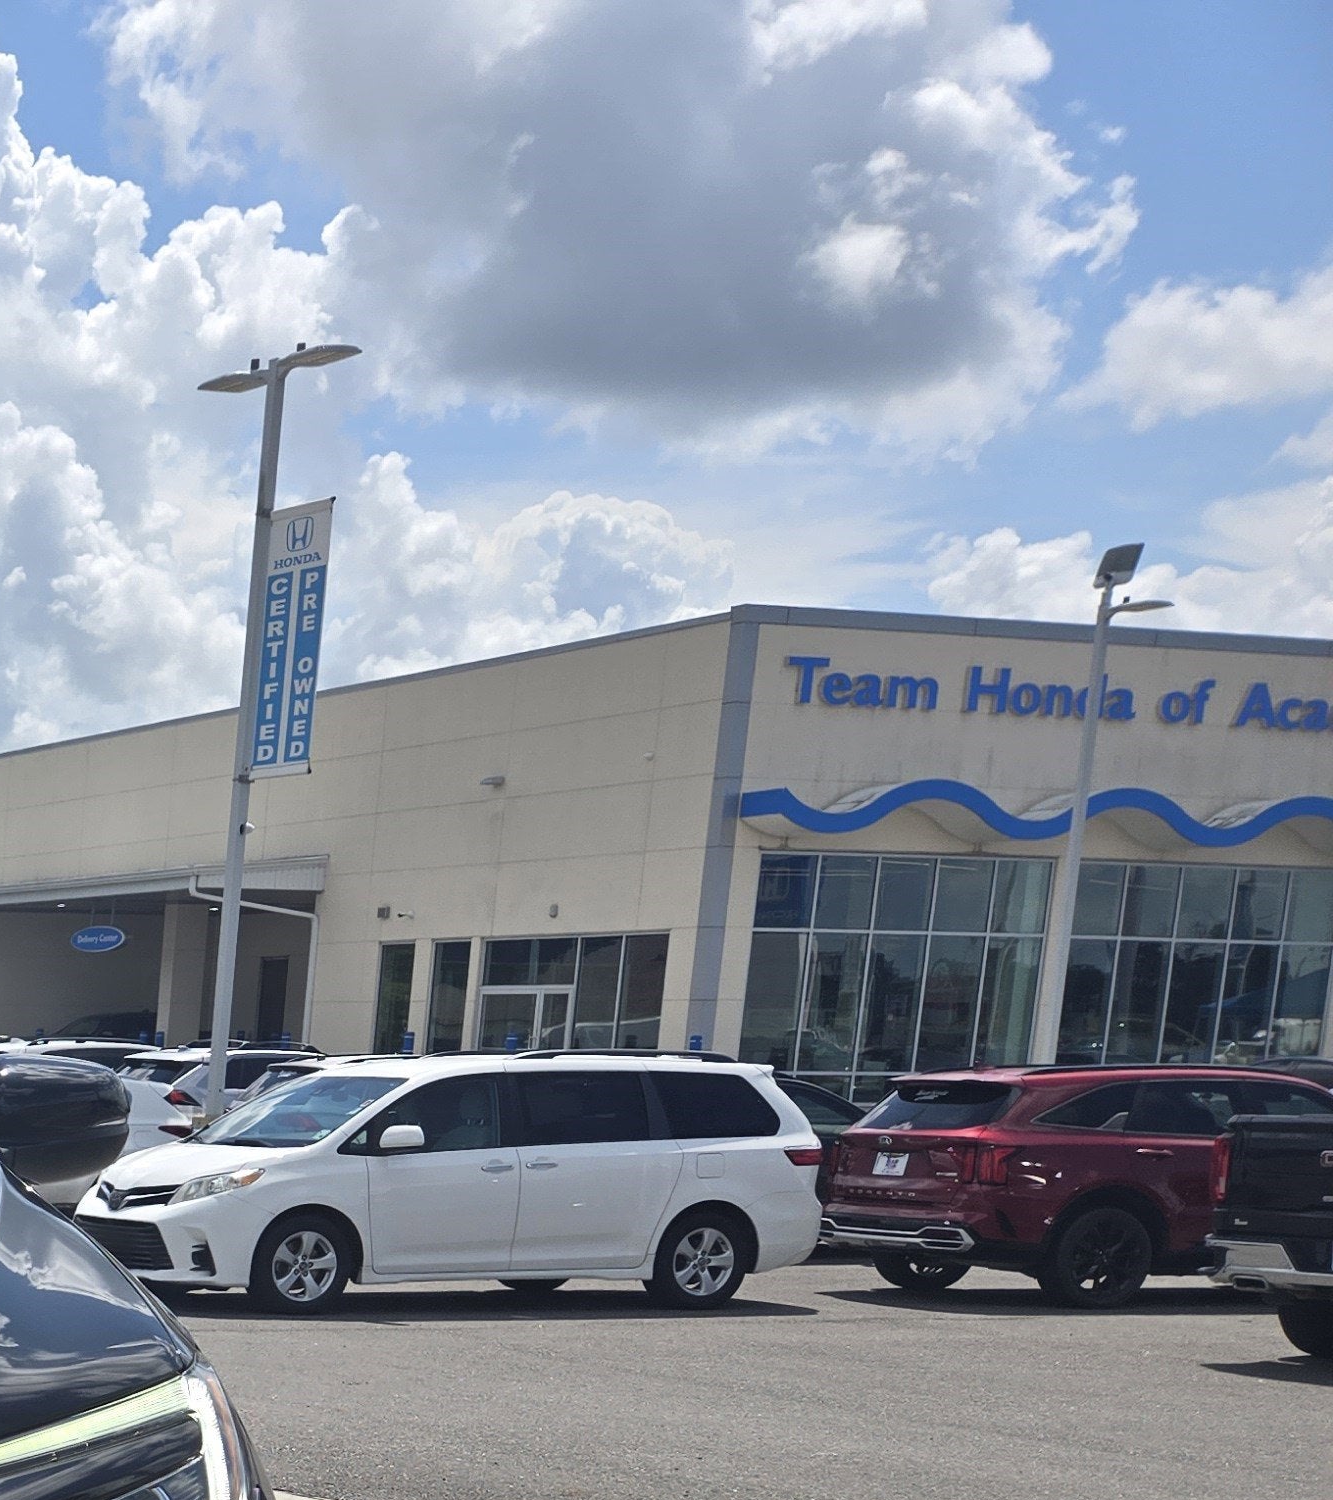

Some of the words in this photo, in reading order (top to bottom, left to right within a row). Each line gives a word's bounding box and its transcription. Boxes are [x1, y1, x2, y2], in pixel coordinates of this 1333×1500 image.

[273, 551, 322, 570] HONDA
[302, 571, 320, 632] PRE
[256, 576, 290, 763] CERTIFIED
[788, 655, 939, 711] Team
[1161, 678, 1217, 726] of
[289, 656, 314, 759] OWNED
